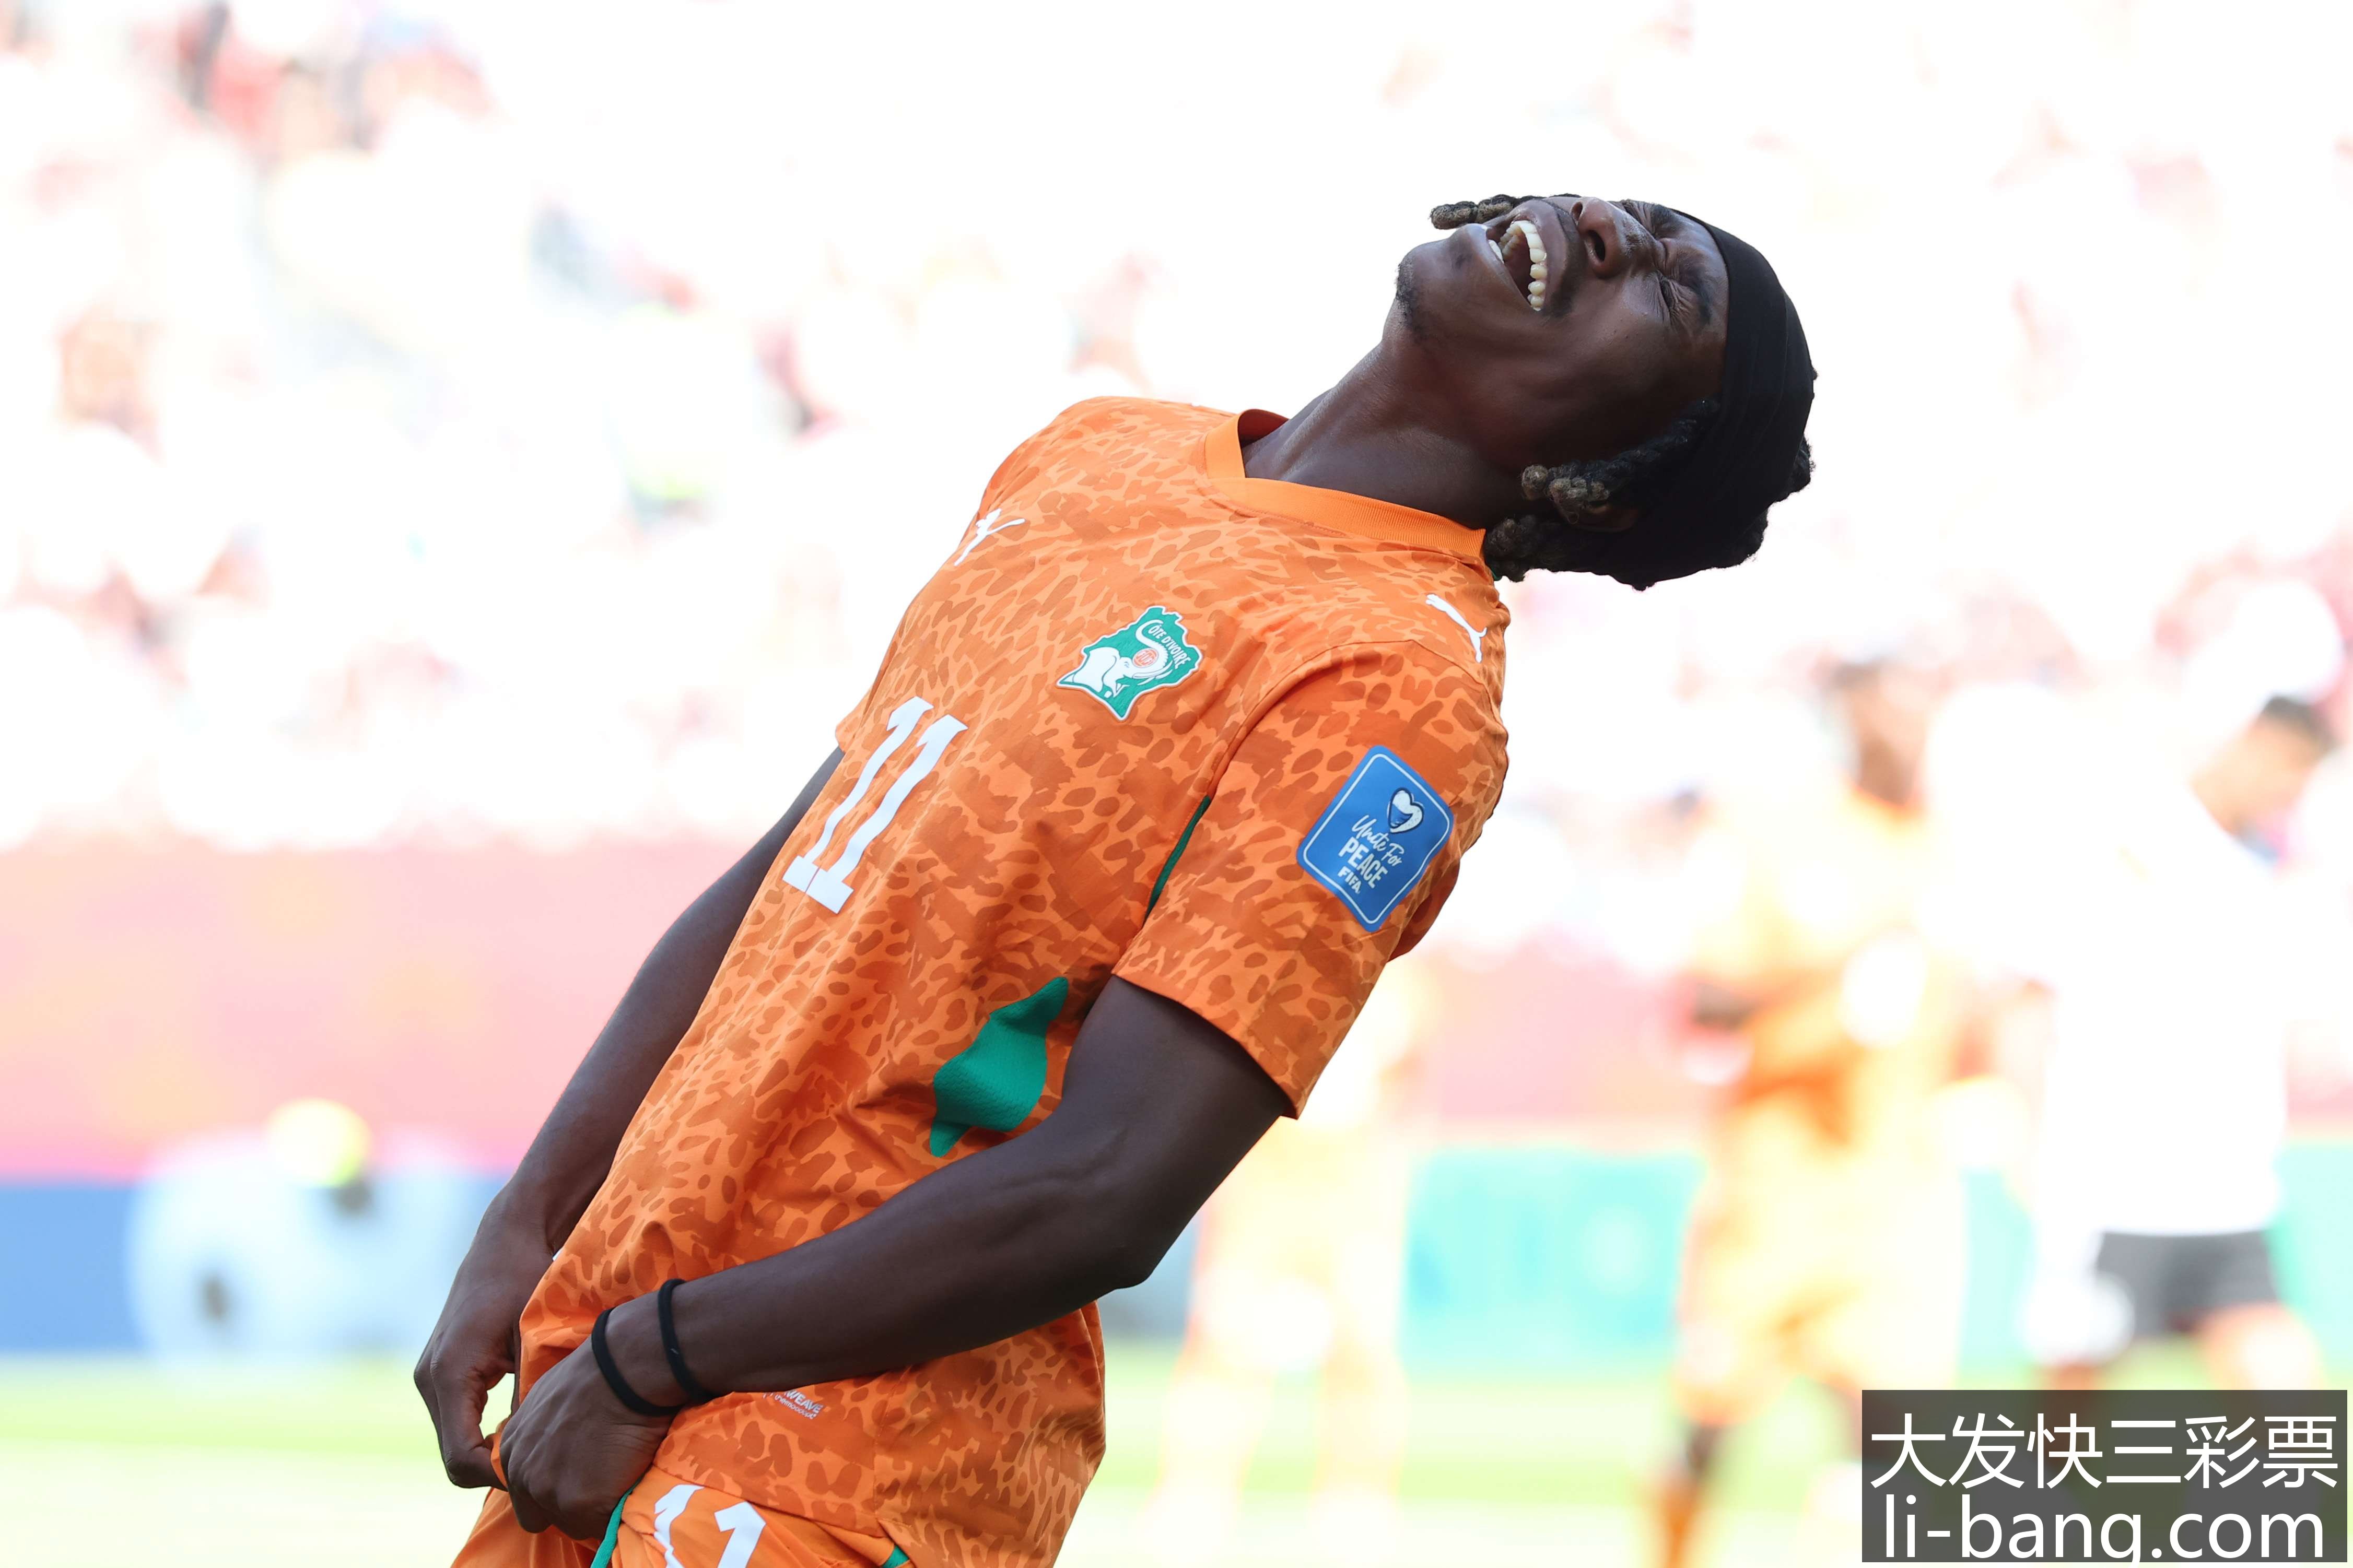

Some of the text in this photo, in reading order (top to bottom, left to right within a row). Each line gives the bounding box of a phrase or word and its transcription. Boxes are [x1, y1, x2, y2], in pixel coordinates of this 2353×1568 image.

[1161, 635, 1191, 669] D'IVOIRE
[783, 695, 969, 914] 11
[1338, 836, 1388, 888] PEACE
[1352, 815, 1405, 867] Unite For
[1338, 866, 1361, 894] FIFA
[783, 1389, 824, 1413] WEAVE
